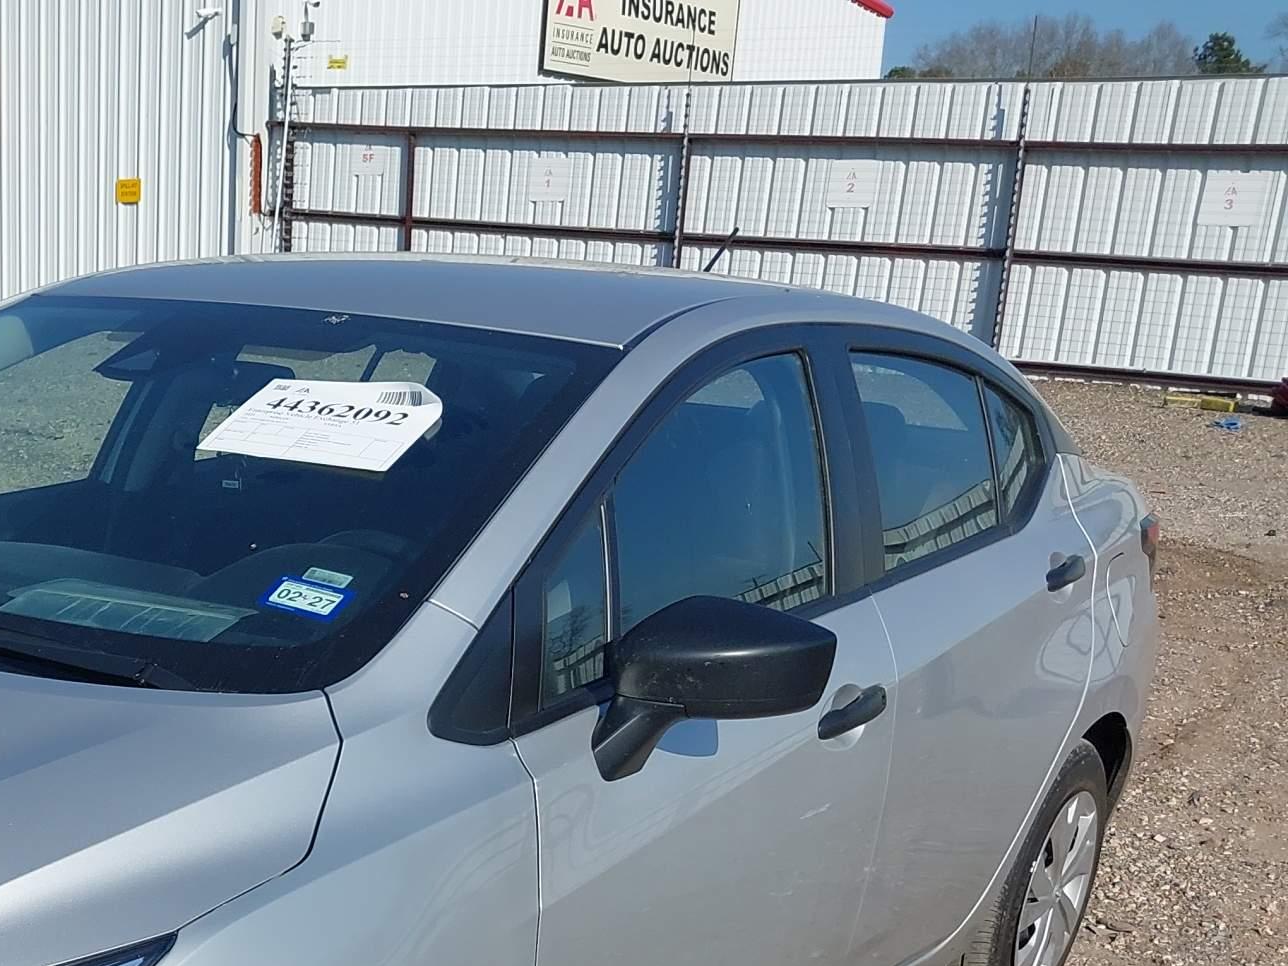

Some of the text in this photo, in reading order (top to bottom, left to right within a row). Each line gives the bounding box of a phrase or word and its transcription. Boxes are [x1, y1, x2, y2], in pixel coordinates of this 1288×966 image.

[621, 0, 716, 35] INSURANCE
[552, 27, 594, 45] INSURANCE
[551, 46, 591, 63] AUTO AUCTIONS
[596, 26, 730, 77] AUTO AUCTIONS
[846, 182, 856, 193] 2
[1223, 198, 1234, 210] 3
[266, 396, 409, 426] 44362092
